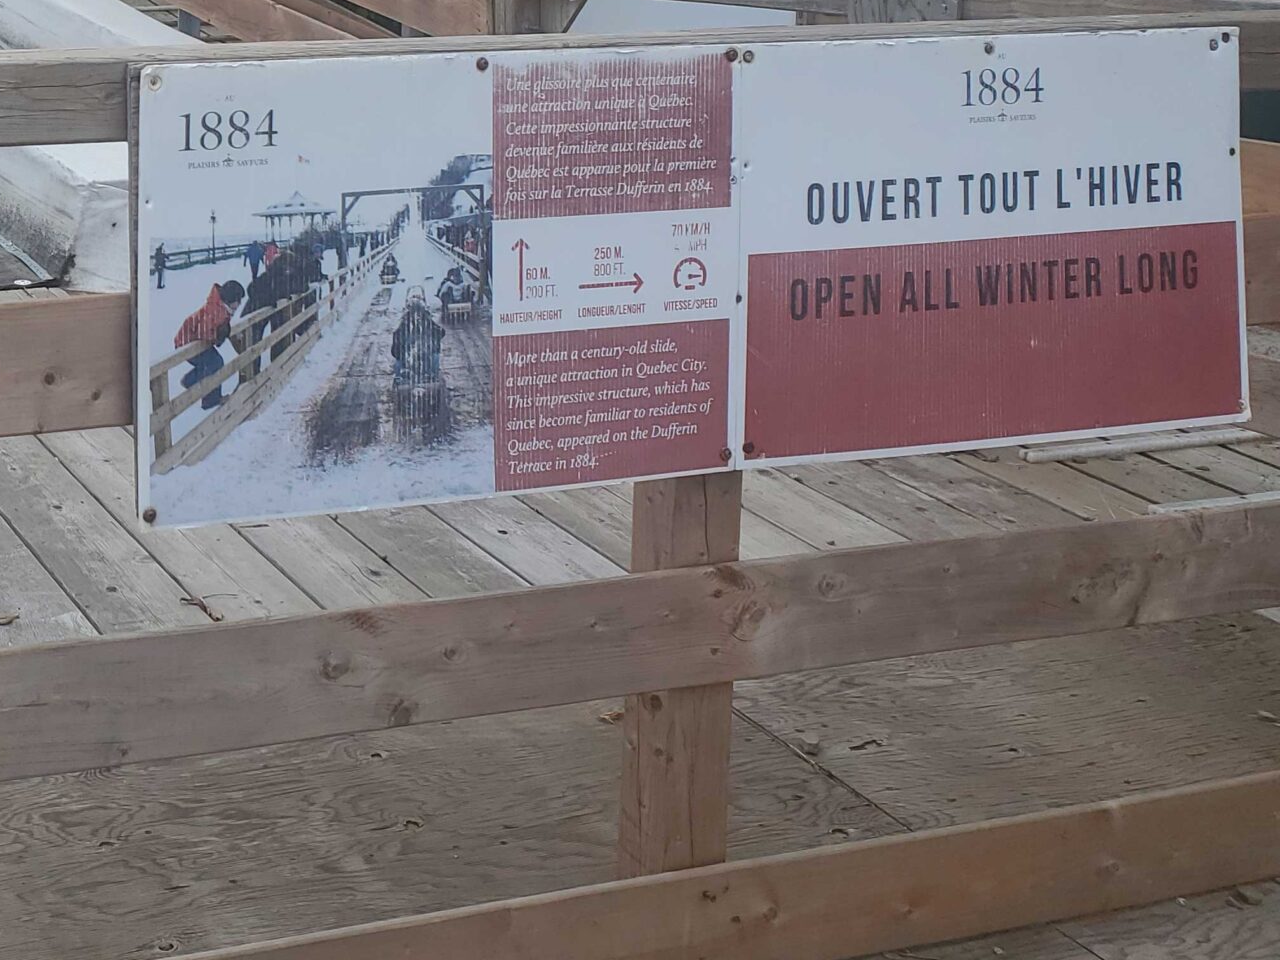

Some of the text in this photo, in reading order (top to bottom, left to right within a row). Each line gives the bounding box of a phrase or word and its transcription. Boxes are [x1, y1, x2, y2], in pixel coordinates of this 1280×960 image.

[506, 77, 531, 91] Une
[533, 77, 582, 94] glissoire
[584, 74, 609, 91] plus
[611, 77, 632, 91] que
[961, 67, 1045, 106] 1884
[506, 100, 528, 113] une
[531, 97, 590, 113] attraction
[594, 95, 635, 112] unique
[648, 93, 693, 111] Québec.
[178, 109, 278, 151] 1884
[506, 117, 691, 137] Cette impressionnante structure
[505, 134, 702, 159] devenue familière aux résidents de
[506, 157, 717, 182] Québec est apparue pour la première
[504, 187, 527, 204] fois
[529, 189, 548, 200] sur
[551, 185, 562, 199] la
[565, 184, 613, 198] Terrasse
[616, 180, 667, 198] Dufferin
[669, 182, 681, 192] en
[807, 161, 1183, 225] OUVERT TOUT L'HIVER
[594, 247, 624, 260] 250 M.
[526, 267, 551, 280] 60 M.
[594, 263, 611, 276] 800
[545, 285, 558, 297] FT.
[790, 249, 1198, 321] OPEN ALL WINTER LONG
[578, 303, 646, 318] LONGUEUR/LENGHT
[664, 298, 718, 311] VITESSE/SPEED
[500, 310, 562, 324] HAUTEUR/HEIGHT
[506, 339, 678, 366] More than a century-old slide,
[506, 358, 707, 388] a unique attraction in Quebec City.
[508, 379, 710, 409] This impressive structure, which has
[506, 399, 713, 431] since become familiar to residents of
[508, 423, 697, 456] Quebec, appeared on the Dufferin
[508, 454, 599, 475] Terrace in 1884.
